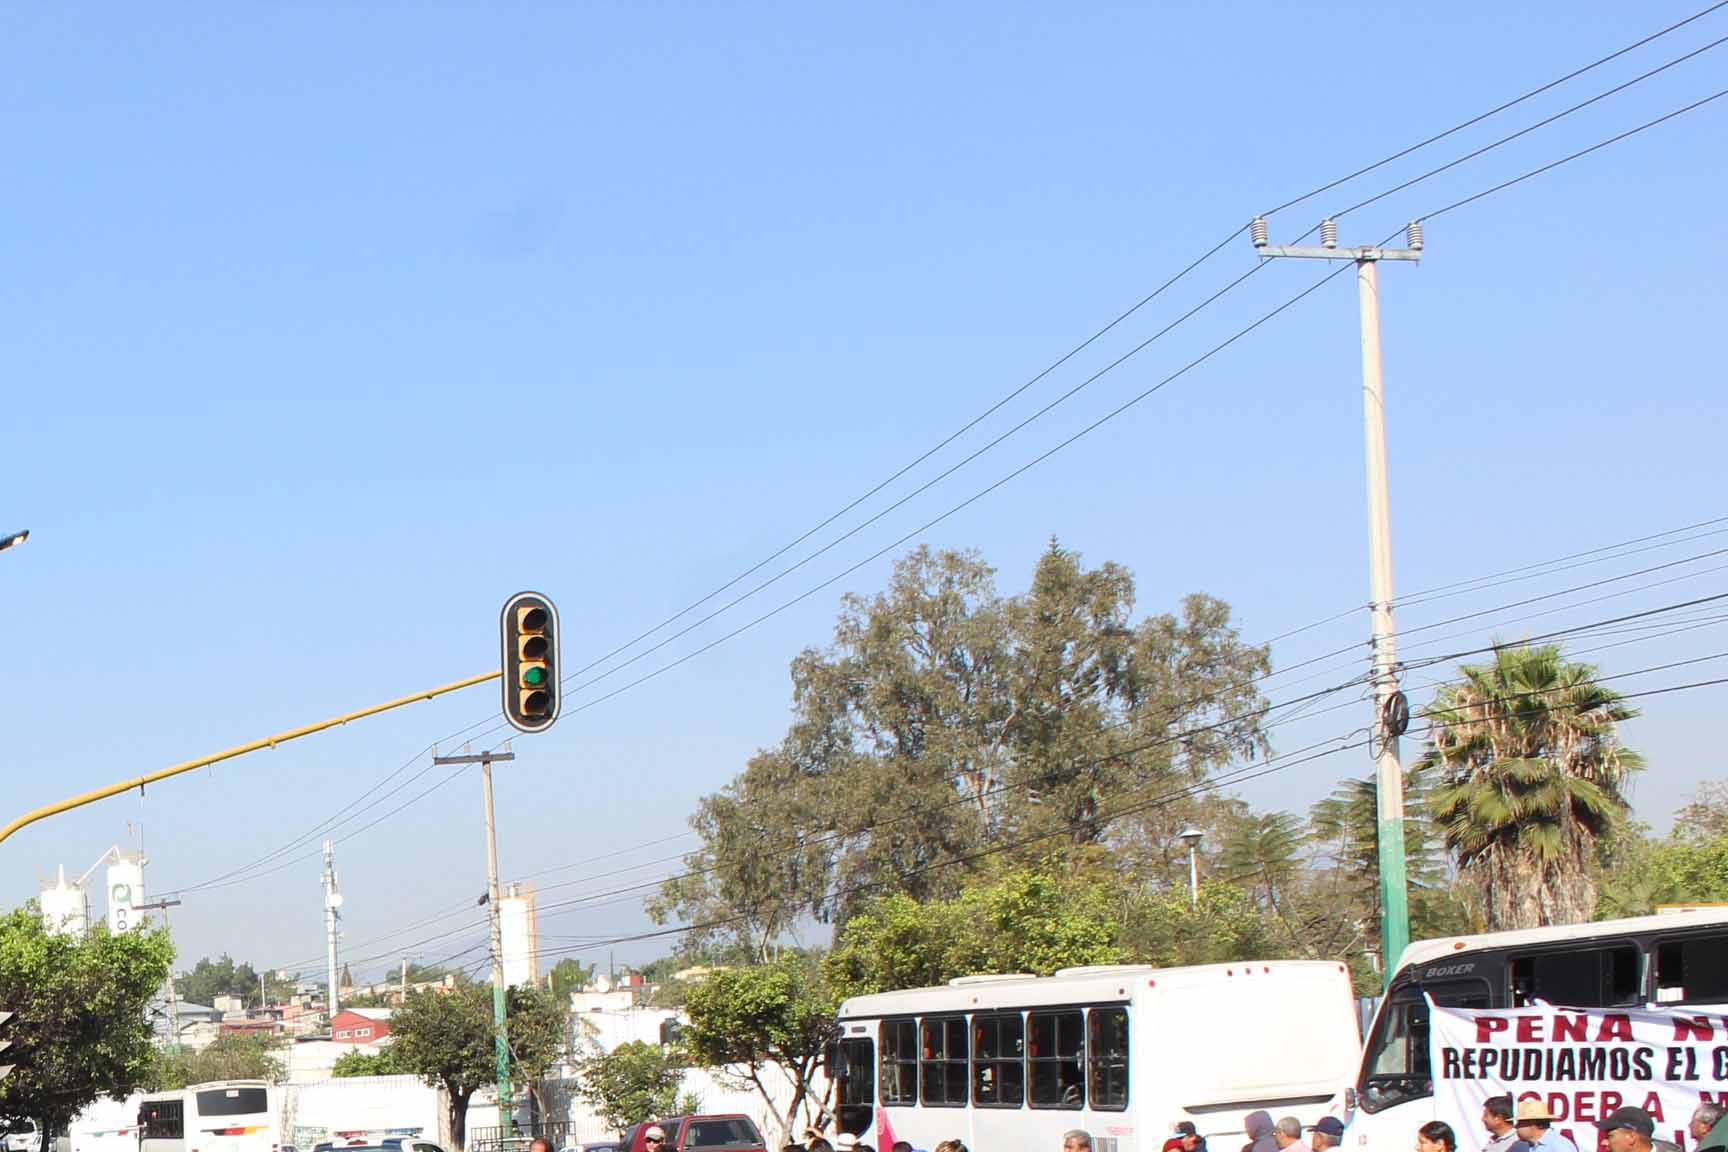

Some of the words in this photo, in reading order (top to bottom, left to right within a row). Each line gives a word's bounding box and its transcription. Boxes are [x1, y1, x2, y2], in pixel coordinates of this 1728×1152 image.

[1425, 963, 1475, 978] BOXER
[1474, 1007, 1637, 1043] PEÑA
[1672, 1015, 1728, 1042] N
[1441, 1046, 1655, 1082] REPUDIAMOS
[1665, 1046, 1701, 1081] EL
[1639, 1090, 1665, 1123] A
